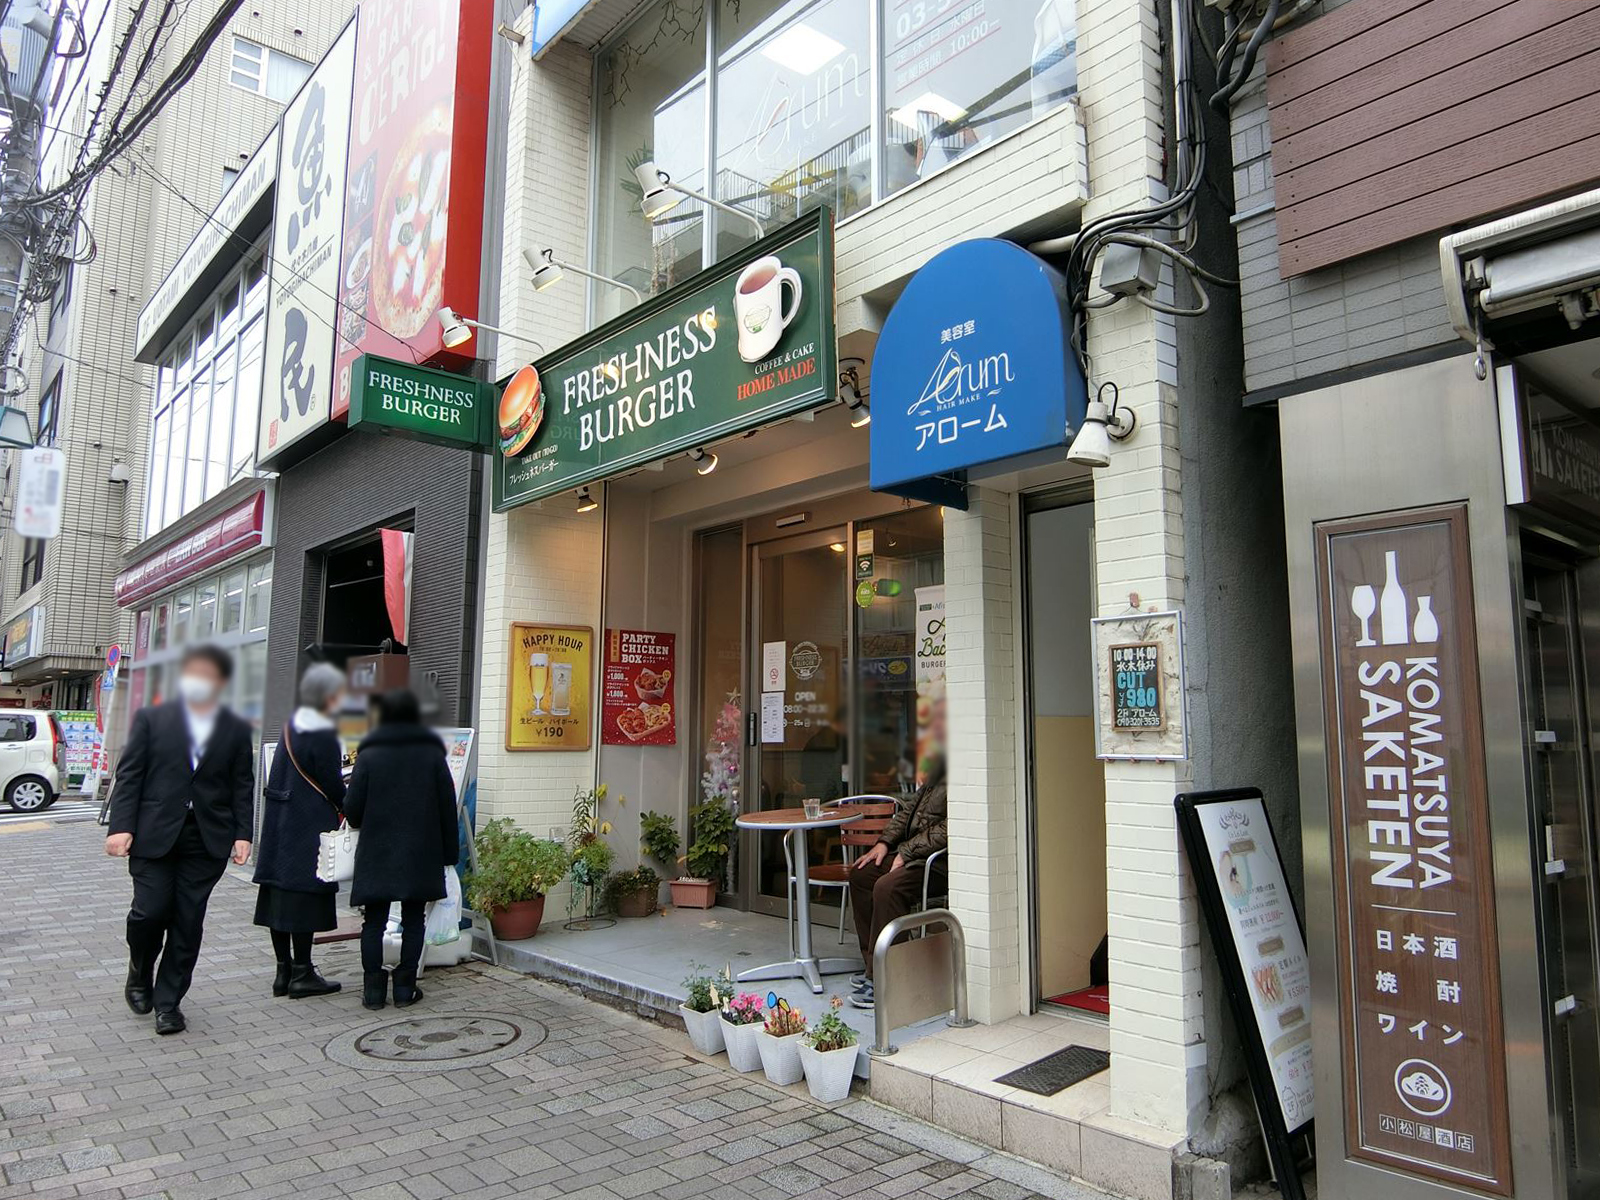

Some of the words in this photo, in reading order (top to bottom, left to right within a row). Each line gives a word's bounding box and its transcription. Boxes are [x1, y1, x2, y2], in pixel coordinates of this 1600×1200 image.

[940, 319, 976, 345] 美容室
[562, 305, 718, 415] FRESHNESS
[754, 355, 783, 375] COFFEE
[784, 352, 792, 363] &
[792, 342, 815, 360] CAKE
[368, 370, 474, 409] FRESHNESS
[736, 372, 775, 401] HOME
[776, 357, 817, 386] MADE
[381, 393, 462, 425] BURGER
[578, 368, 696, 452] BURGER
[936, 400, 957, 412] HAIR
[958, 393, 981, 406] MAKE
[914, 403, 1008, 451] アローム
[522, 633, 555, 649] HAPPY
[558, 634, 584, 652] HOUR
[621, 644, 670, 656] CHICKEN
[622, 633, 657, 644] PARTY
[621, 654, 642, 664] BOX
[1117, 671, 1146, 689] CUT
[794, 691, 817, 702] OPEN
[1131, 709, 1157, 718] アローム
[1357, 660, 1415, 889] SAKETEN
[1404, 656, 1453, 889] KOMATSUYA
[1375, 929, 1458, 960] 日本酒
[1375, 970, 1461, 1003] 焼酎
[1377, 1012, 1464, 1045] ワイン
[1379, 1113, 1474, 1152] 小松屋酒店
